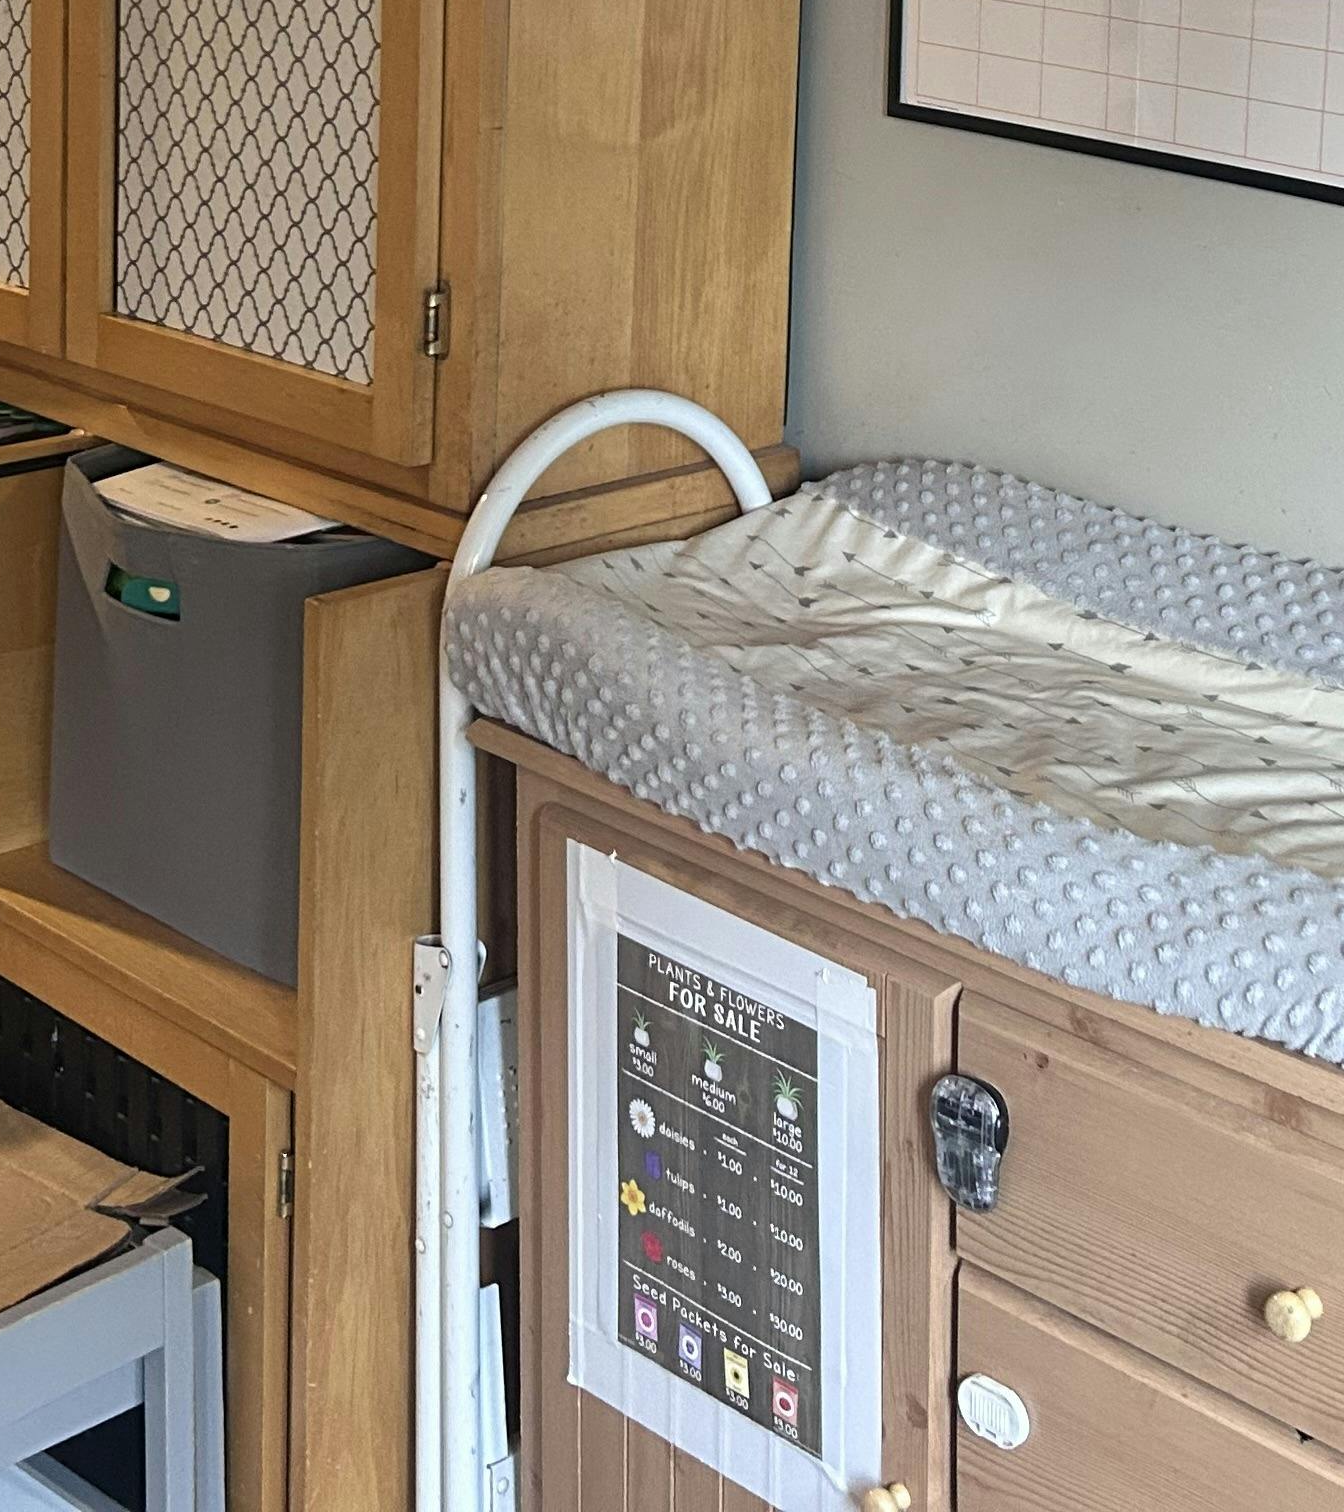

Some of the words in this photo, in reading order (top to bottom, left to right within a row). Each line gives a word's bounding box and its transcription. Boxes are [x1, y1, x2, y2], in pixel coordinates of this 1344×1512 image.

[648, 953, 702, 990] PLANTS
[706, 980, 715, 997] &
[720, 987, 785, 1030] FLOWERS
[669, 981, 706, 1017] FOR
[713, 1003, 761, 1043] SALE
[629, 1042, 657, 1065] small
[632, 1056, 654, 1078] $3.00
[691, 1074, 736, 1105] medium
[702, 1092, 726, 1113] $6.00
[773, 1111, 802, 1138] large
[772, 1128, 803, 1153] $10.00
[658, 1122, 696, 1151] daisies
[717, 1151, 743, 1176] $1.00
[770, 1179, 803, 1206] $10.00
[775, 1159, 787, 1171] for
[789, 1166, 799, 1178] 12
[665, 1168, 695, 1194] tulips
[717, 1195, 742, 1219] $1.00
[770, 1223, 804, 1251] $10.00
[649, 1201, 696, 1238] daffodils
[717, 1239, 742, 1263] $2.00
[770, 1268, 804, 1295] $20.00
[666, 1256, 696, 1281] roses
[717, 1283, 742, 1308] $3.00
[769, 1313, 804, 1340] $30.00
[632, 1274, 667, 1305] Seed
[672, 1297, 728, 1343] Packets
[734, 1334, 757, 1359] for
[635, 1331, 657, 1354] $3.00
[679, 1360, 702, 1382] $3.00
[725, 1388, 749, 1410] $3.00
[773, 1415, 798, 1439] $3.00
